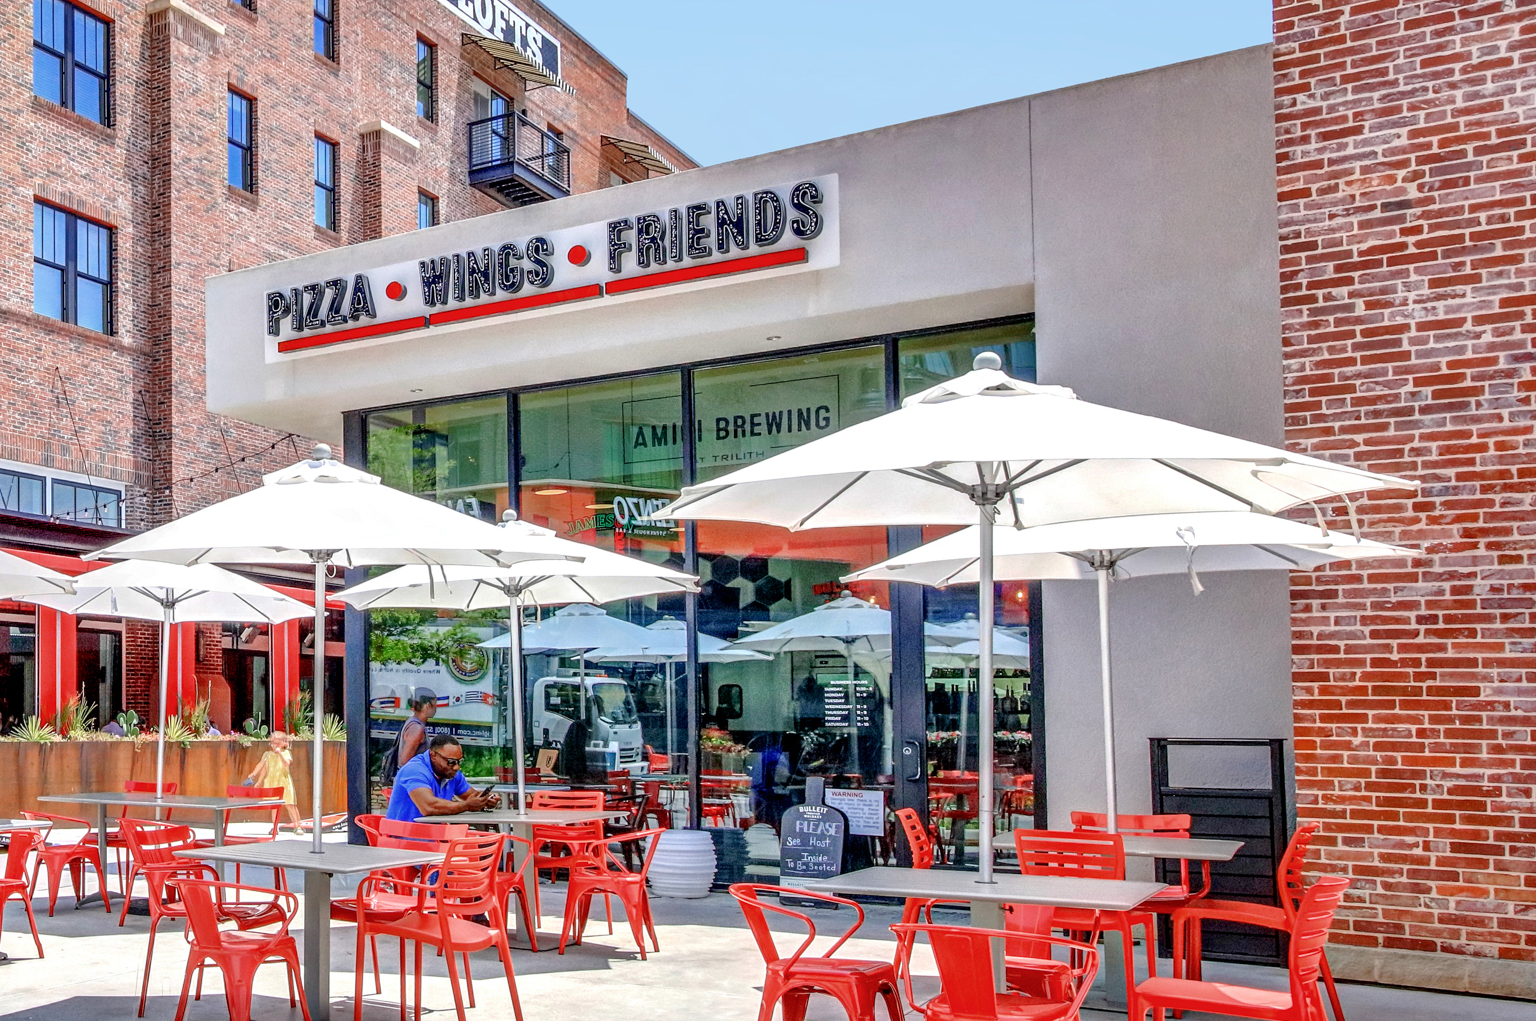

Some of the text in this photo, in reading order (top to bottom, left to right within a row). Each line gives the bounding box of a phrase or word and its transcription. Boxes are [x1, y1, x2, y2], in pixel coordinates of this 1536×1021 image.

[267, 181, 823, 337] PIZZA WINGS FRIENDS
[634, 405, 831, 449] AMII BREWING
[712, 451, 764, 462] TRILITH
[799, 806, 828, 814] BULLEIT
[796, 820, 842, 836] PLEASE
[786, 836, 831, 848] See Host
[801, 853, 828, 862] Inside
[785, 859, 794, 868] To
[809, 863, 837, 871] Seated
